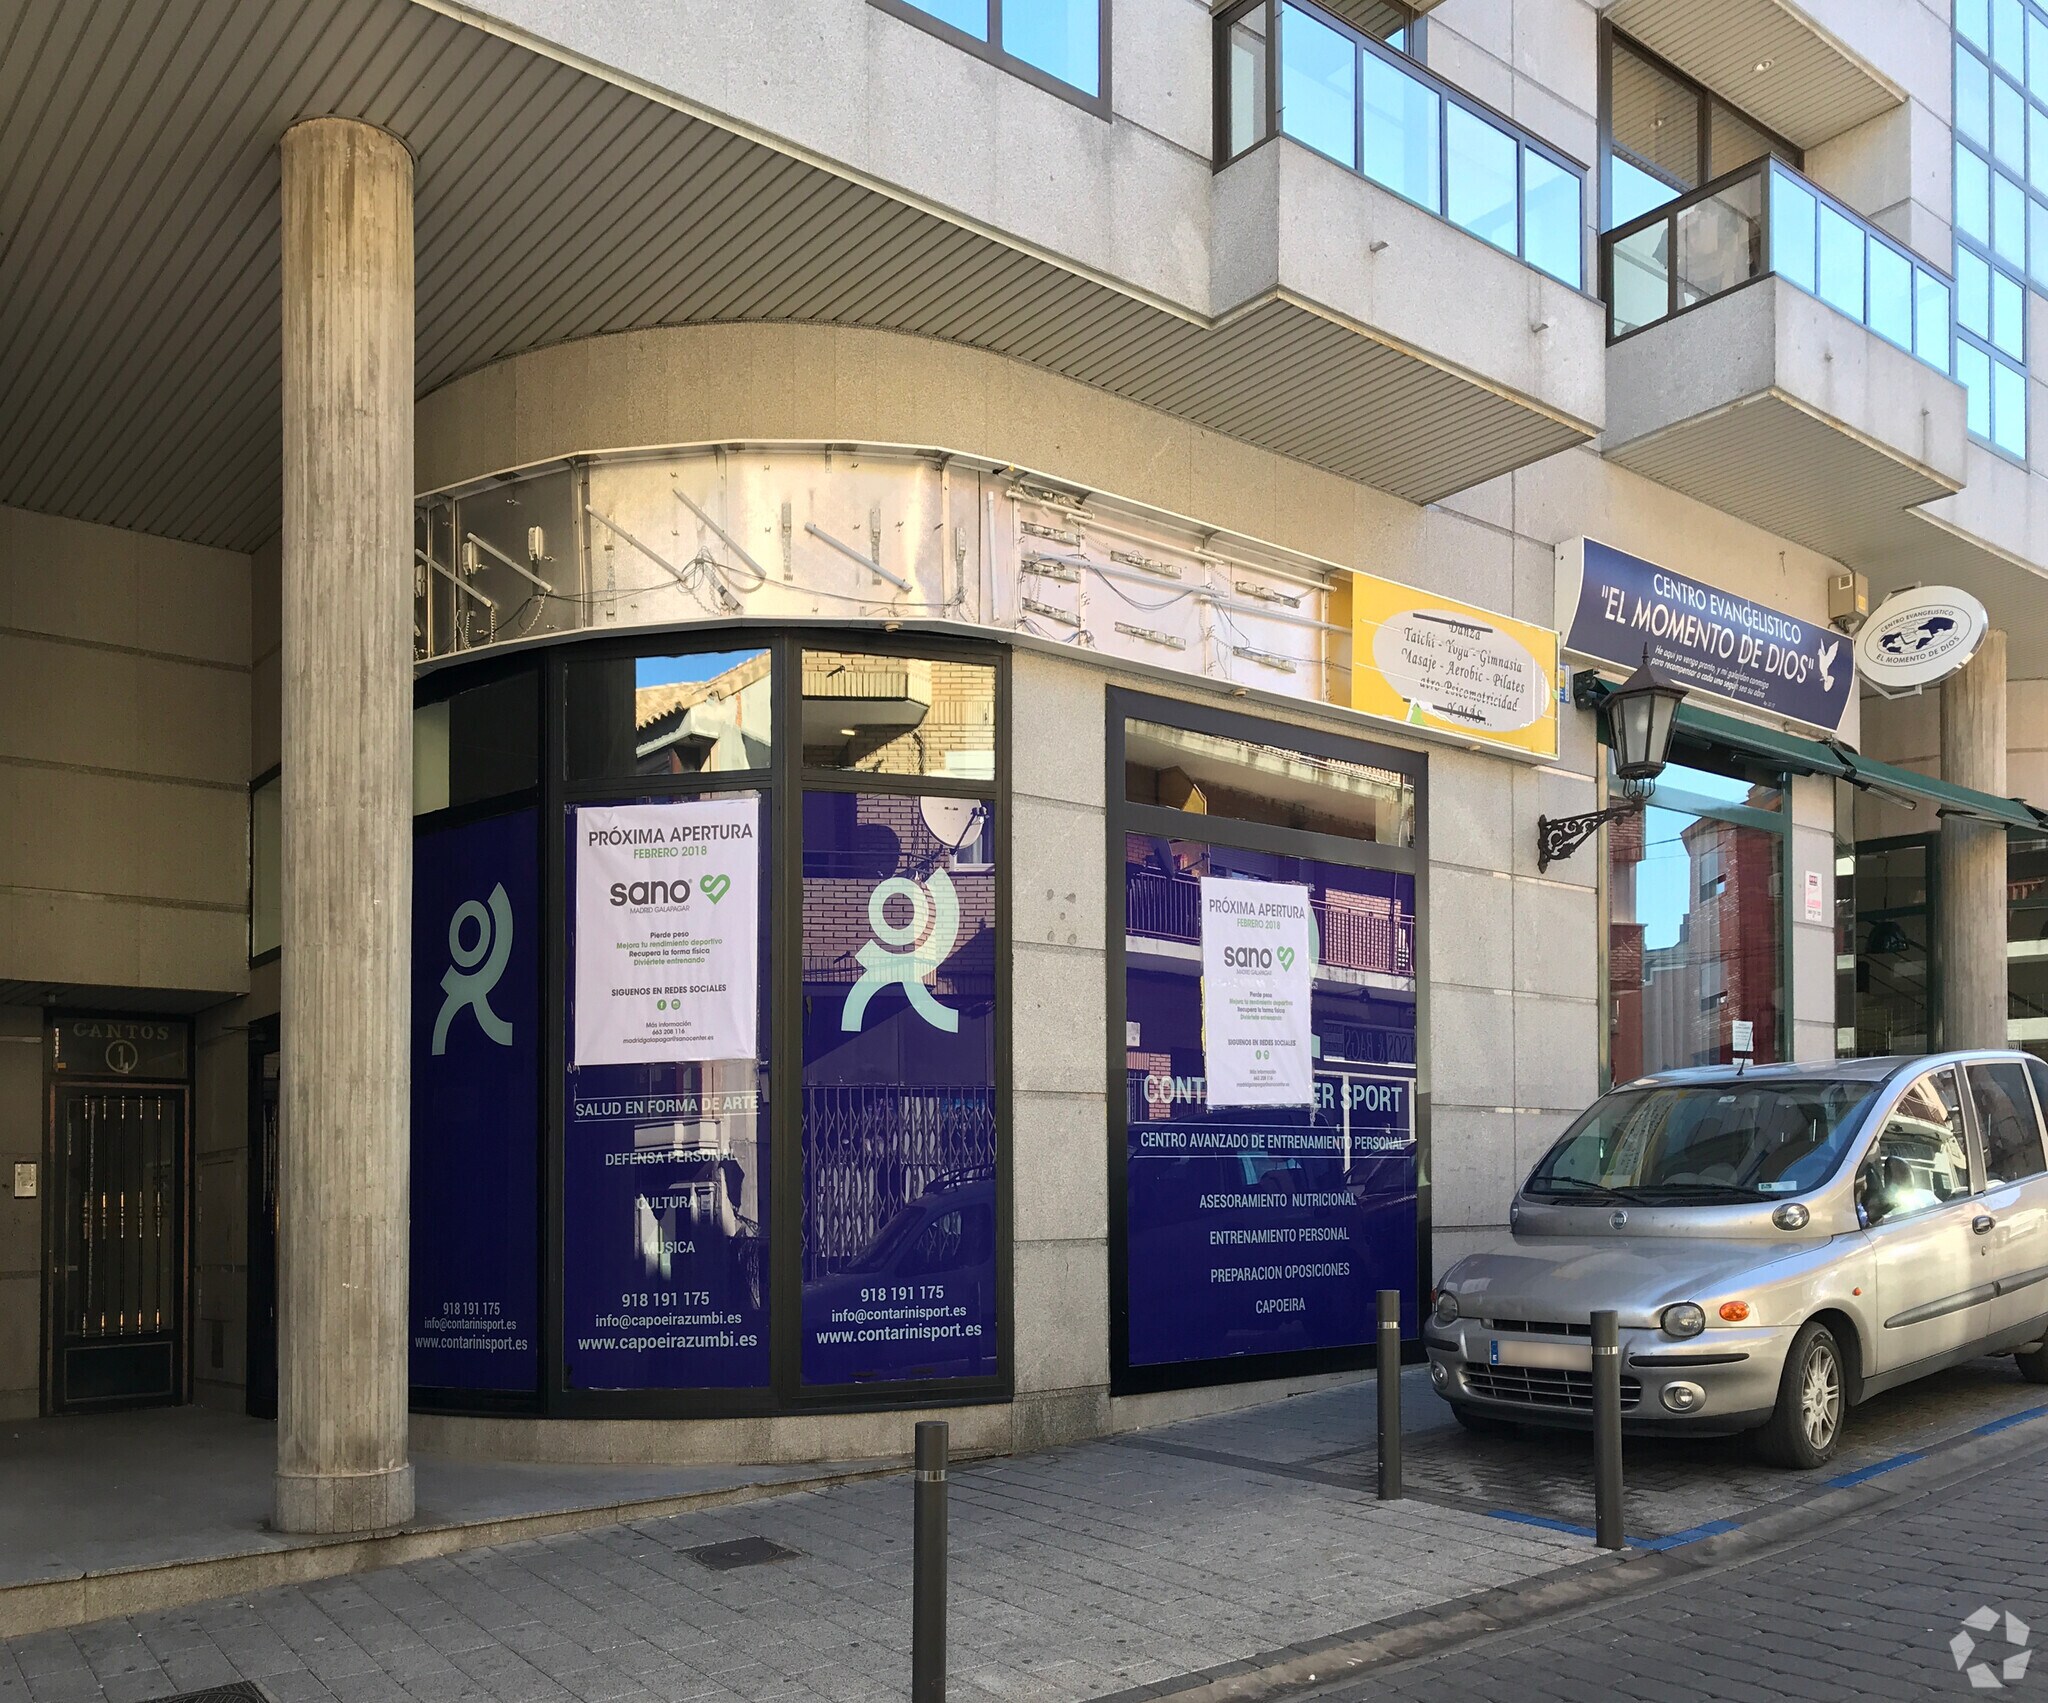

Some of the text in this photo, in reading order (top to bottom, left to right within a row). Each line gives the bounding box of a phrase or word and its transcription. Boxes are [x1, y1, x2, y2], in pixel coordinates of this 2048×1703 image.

[1653, 573, 1802, 645] CENTRO EVANGELISTICO
[1880, 609, 1954, 633] CENTRO EVANGELISTICO
[1631, 597, 1735, 659] MOMENTO
[1738, 634, 1763, 668] DE
[1404, 626, 1435, 649] Taichi
[1479, 649, 1522, 673] Gimnasia
[1876, 635, 1960, 664] EL MOMENTO DE DIOS
[1445, 661, 1483, 682] Aerobic
[1493, 673, 1525, 694] Pilates
[588, 823, 753, 847] PRÓXIMA APERTURA
[633, 845, 707, 859] FEBRERO 2018
[609, 879, 691, 906] sano
[630, 905, 690, 914] MADRID GALAPAGAR
[1209, 896, 1305, 919] PRÓXIMA APERTURA
[1237, 918, 1280, 930] FEBRERO 2018
[616, 942, 639, 950] Mejora
[649, 939, 689, 948] rendimiento
[691, 938, 723, 947] deportivo
[650, 931, 689, 939] Pierde peso
[629, 950, 661, 958] Recupera
[671, 948, 690, 956] forma
[667, 957, 705, 965] entrenando
[1224, 946, 1272, 969] sano
[611, 984, 727, 997] SIGUENOS EN REDES SOCIALES
[73, 1022, 169, 1040] CANTOS
[575, 1095, 759, 1117] SALUD EN FORMA DE ARTE
[1341, 1083, 1403, 1112] SPORT
[1140, 1131, 1405, 1150] CENTRO AVANZADO DE ENTRENAMIENTO PERSONAL
[605, 1149, 738, 1166] DEFENSA PERSONAL
[637, 1195, 698, 1209] CULTURA
[1199, 1192, 1357, 1209] ASESORAMIENTO NUTRICIONAL
[1209, 1227, 1350, 1245] ENTRENAMIENTO PERSONAL
[1210, 1262, 1350, 1283] PREPARACION OPOSICIONES
[621, 1291, 710, 1307] 918 191 175
[860, 1285, 944, 1302] 918 191 175
[443, 1301, 500, 1316] 918 191 175
[831, 1304, 967, 1324] info@contarinisport.es
[1255, 1297, 1306, 1314] CAPOEIRA
[424, 1317, 517, 1332] info@contarinisport.es
[595, 1310, 742, 1330] info@capoeirazumbi.es
[577, 1331, 758, 1353] www.capoeirazumbi.es
[816, 1323, 982, 1344] www.contarinisport.es
[415, 1334, 528, 1354] www.contarinisport.es
